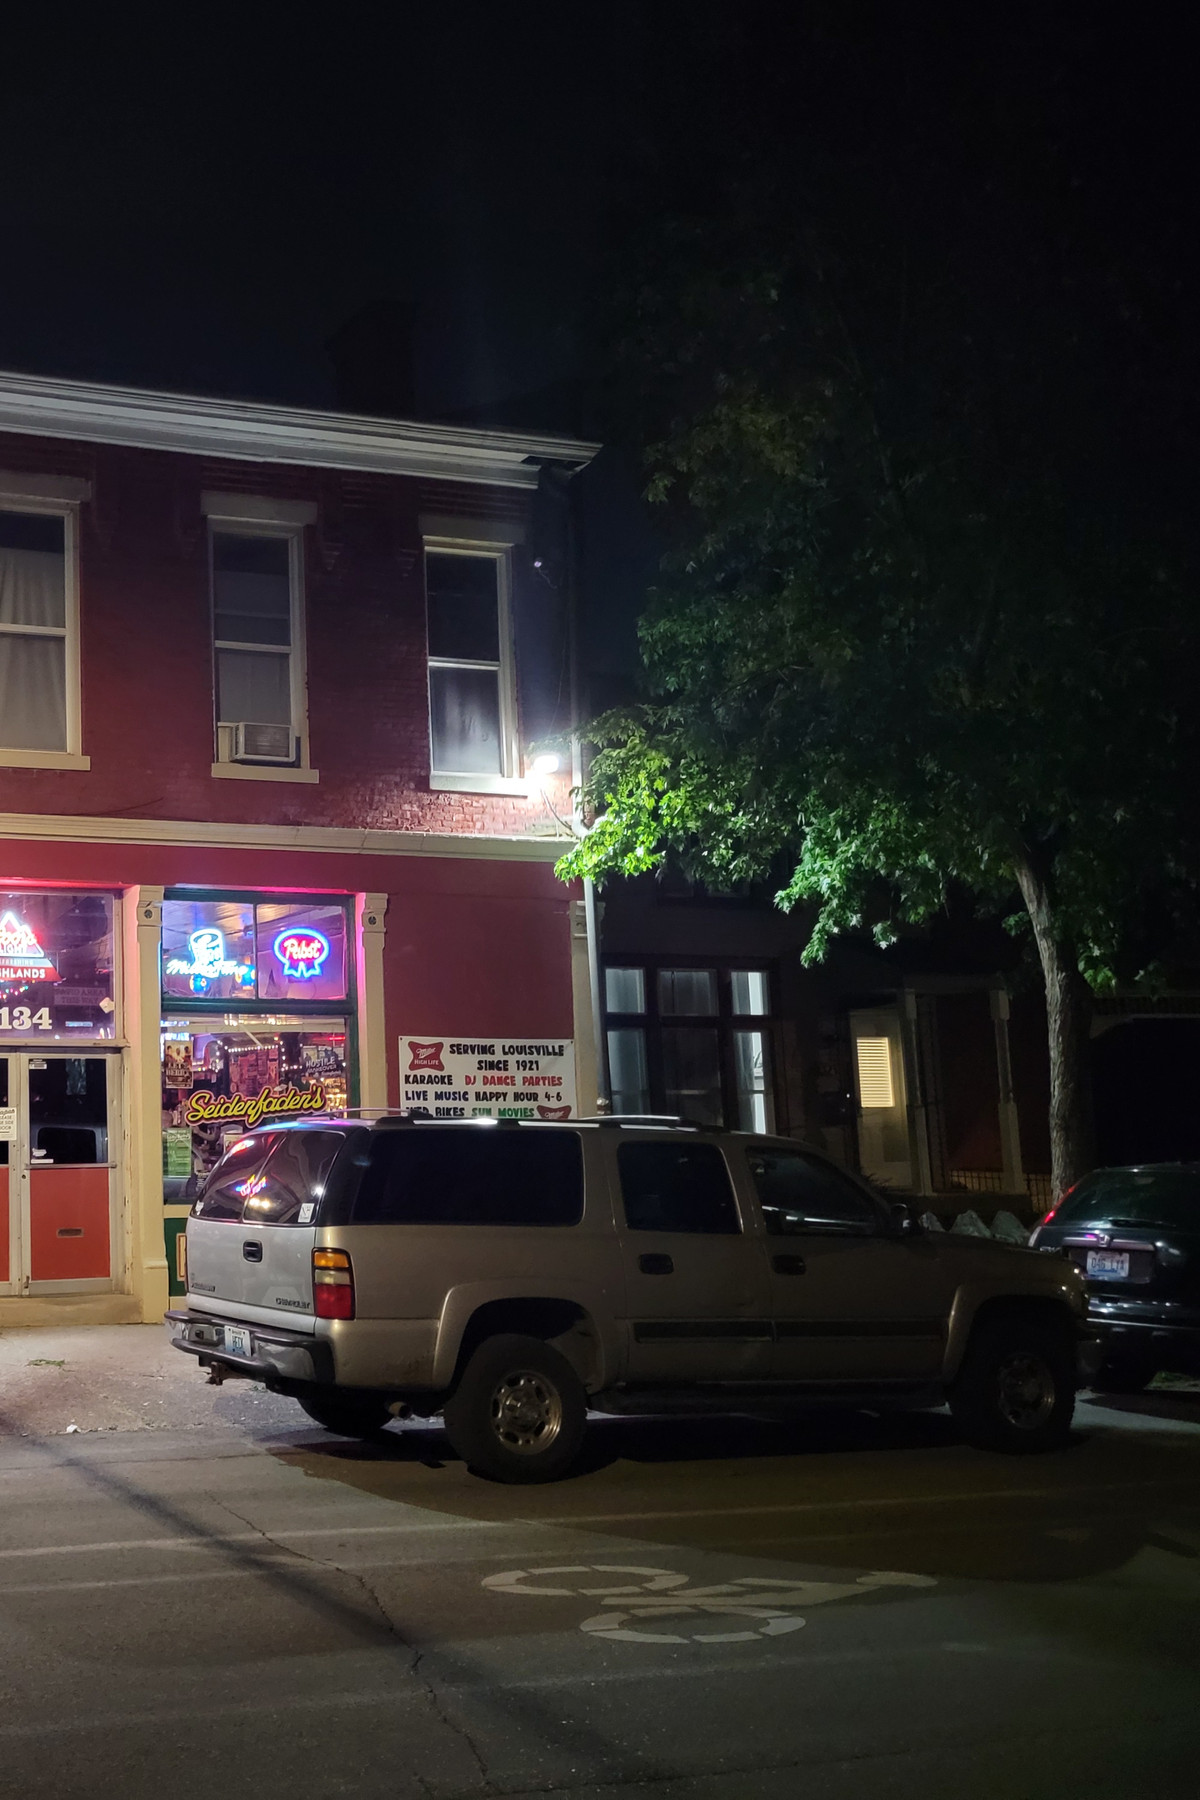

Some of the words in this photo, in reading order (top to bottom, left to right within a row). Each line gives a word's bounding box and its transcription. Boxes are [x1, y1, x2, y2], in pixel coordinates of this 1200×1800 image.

[283, 938, 322, 960] Pabst
[449, 1043, 495, 1056] SERVING
[502, 1044, 564, 1057] LOUISVILLE
[477, 1060, 509, 1072] SINCE
[516, 1060, 539, 1072] 1921
[404, 1074, 453, 1086] KARAOKE
[465, 1075, 476, 1086] DJ
[482, 1075, 516, 1086] DANCE
[522, 1075, 563, 1087] PARTIES
[405, 1090, 428, 1101] LIVE
[434, 1090, 469, 1102] MUSIC
[475, 1091, 508, 1102] HAPPY
[513, 1091, 539, 1102] HOUR
[545, 1091, 562, 1102] 4-6
[186, 1084, 326, 1127] Seidenfaden's
[435, 1106, 465, 1117] BIKES
[471, 1107, 492, 1116] SUN
[498, 1107, 535, 1117] MOVIES
